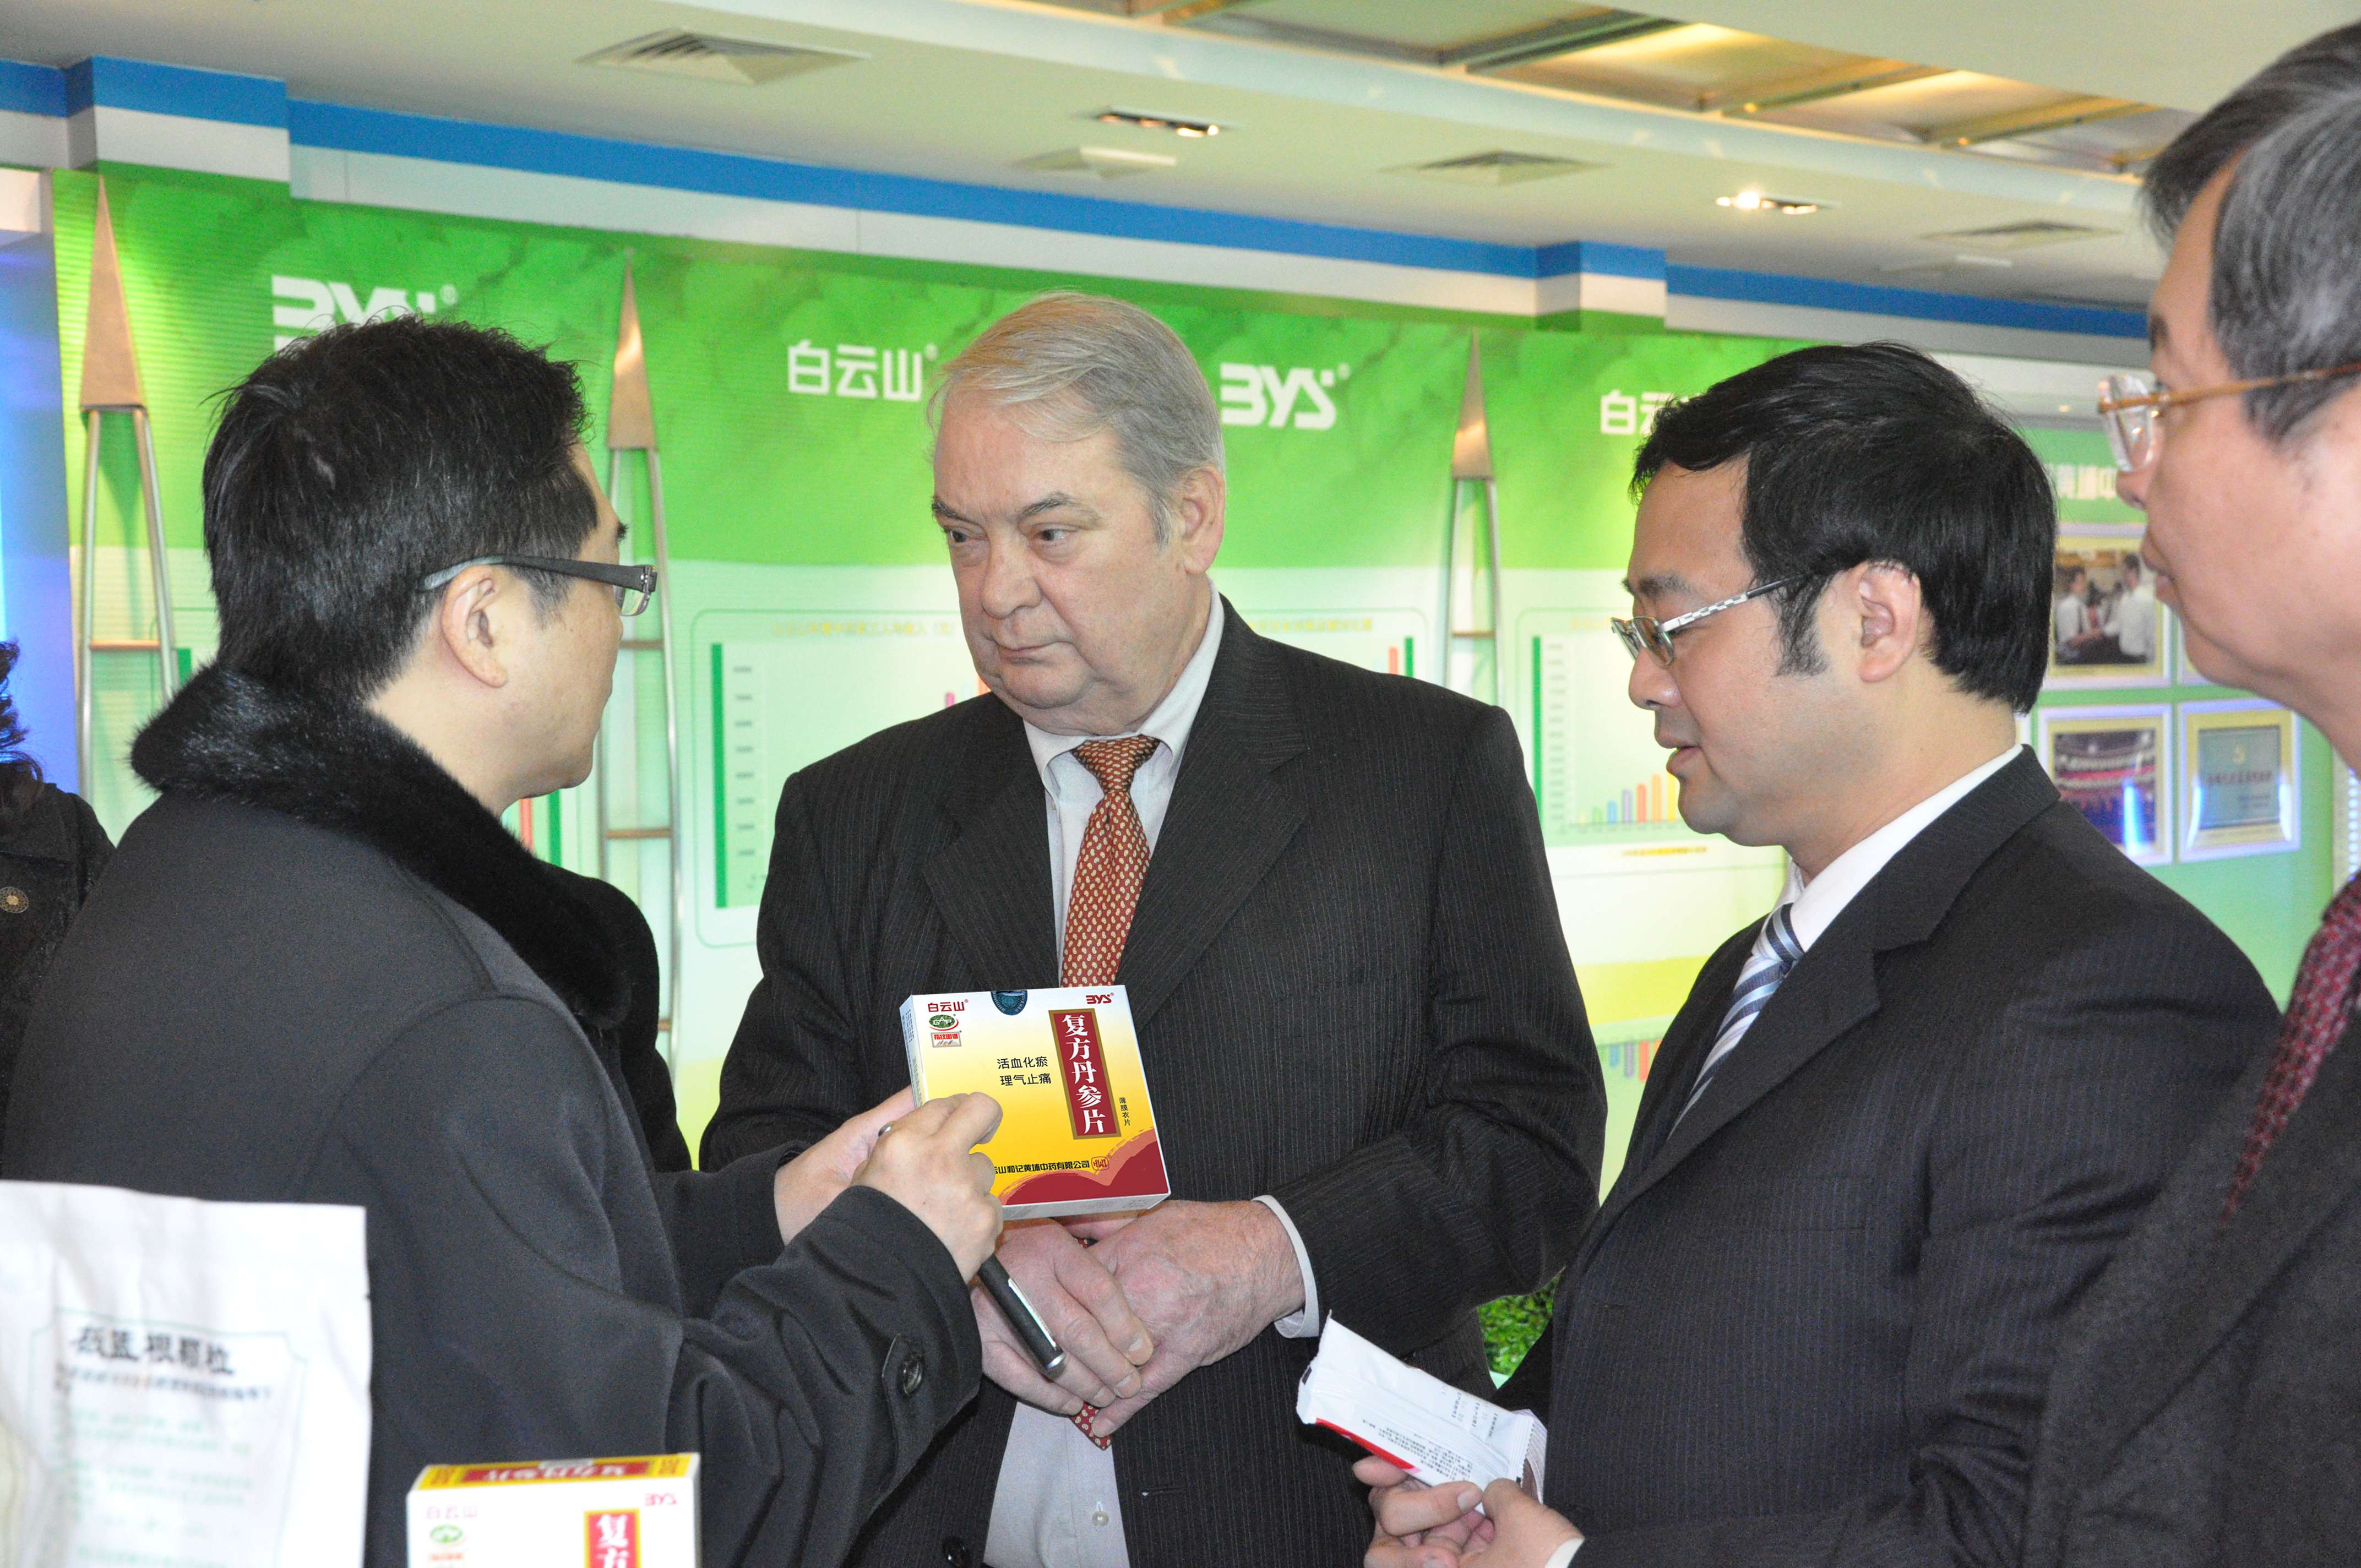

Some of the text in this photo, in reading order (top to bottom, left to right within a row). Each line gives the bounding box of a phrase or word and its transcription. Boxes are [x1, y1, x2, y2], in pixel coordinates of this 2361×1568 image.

[788, 341, 922, 401] 白云山
[1220, 363, 1336, 429] BYS
[1086, 994, 1112, 1004] BYS
[928, 1001, 965, 1012] 白云山
[933, 1017, 952, 1025] GAP
[997, 1056, 1048, 1069] 活血化瘀
[1000, 1073, 1051, 1086] 理气止痛
[1062, 1015, 1106, 1134] 复方丹参片
